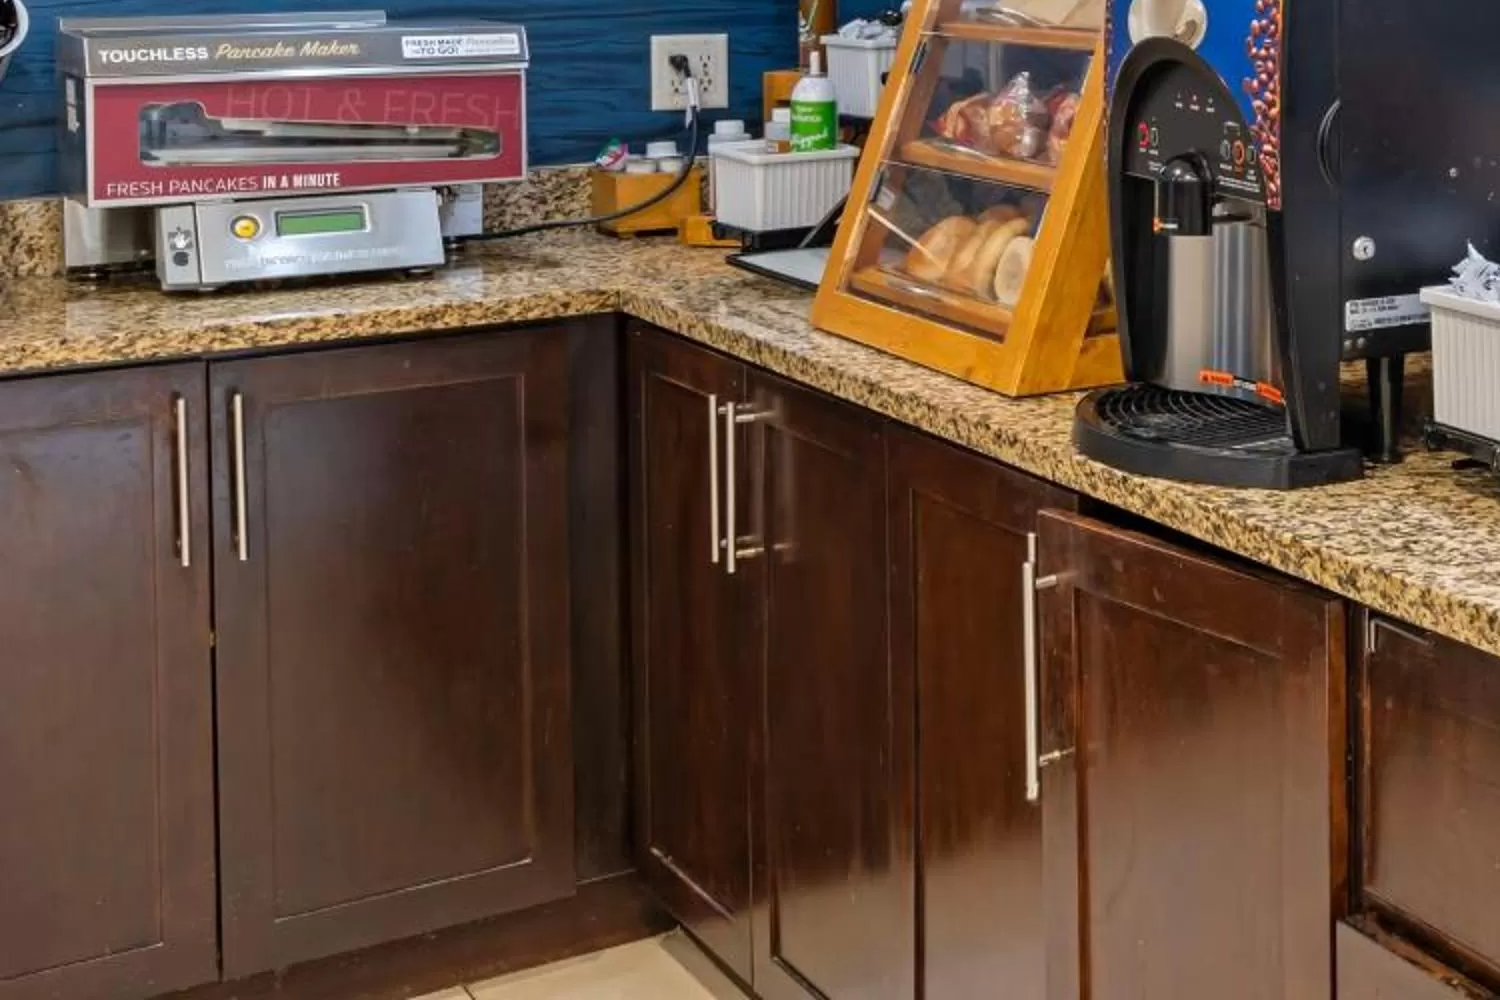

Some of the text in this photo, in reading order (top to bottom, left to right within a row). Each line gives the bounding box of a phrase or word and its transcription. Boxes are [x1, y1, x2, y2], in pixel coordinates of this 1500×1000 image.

[100, 40, 360, 64] TOUCHLESS Pancake Maker
[227, 86, 519, 130] HOT & FRESH
[107, 173, 341, 197] FRESH PANCAKES IN A MINUTE
